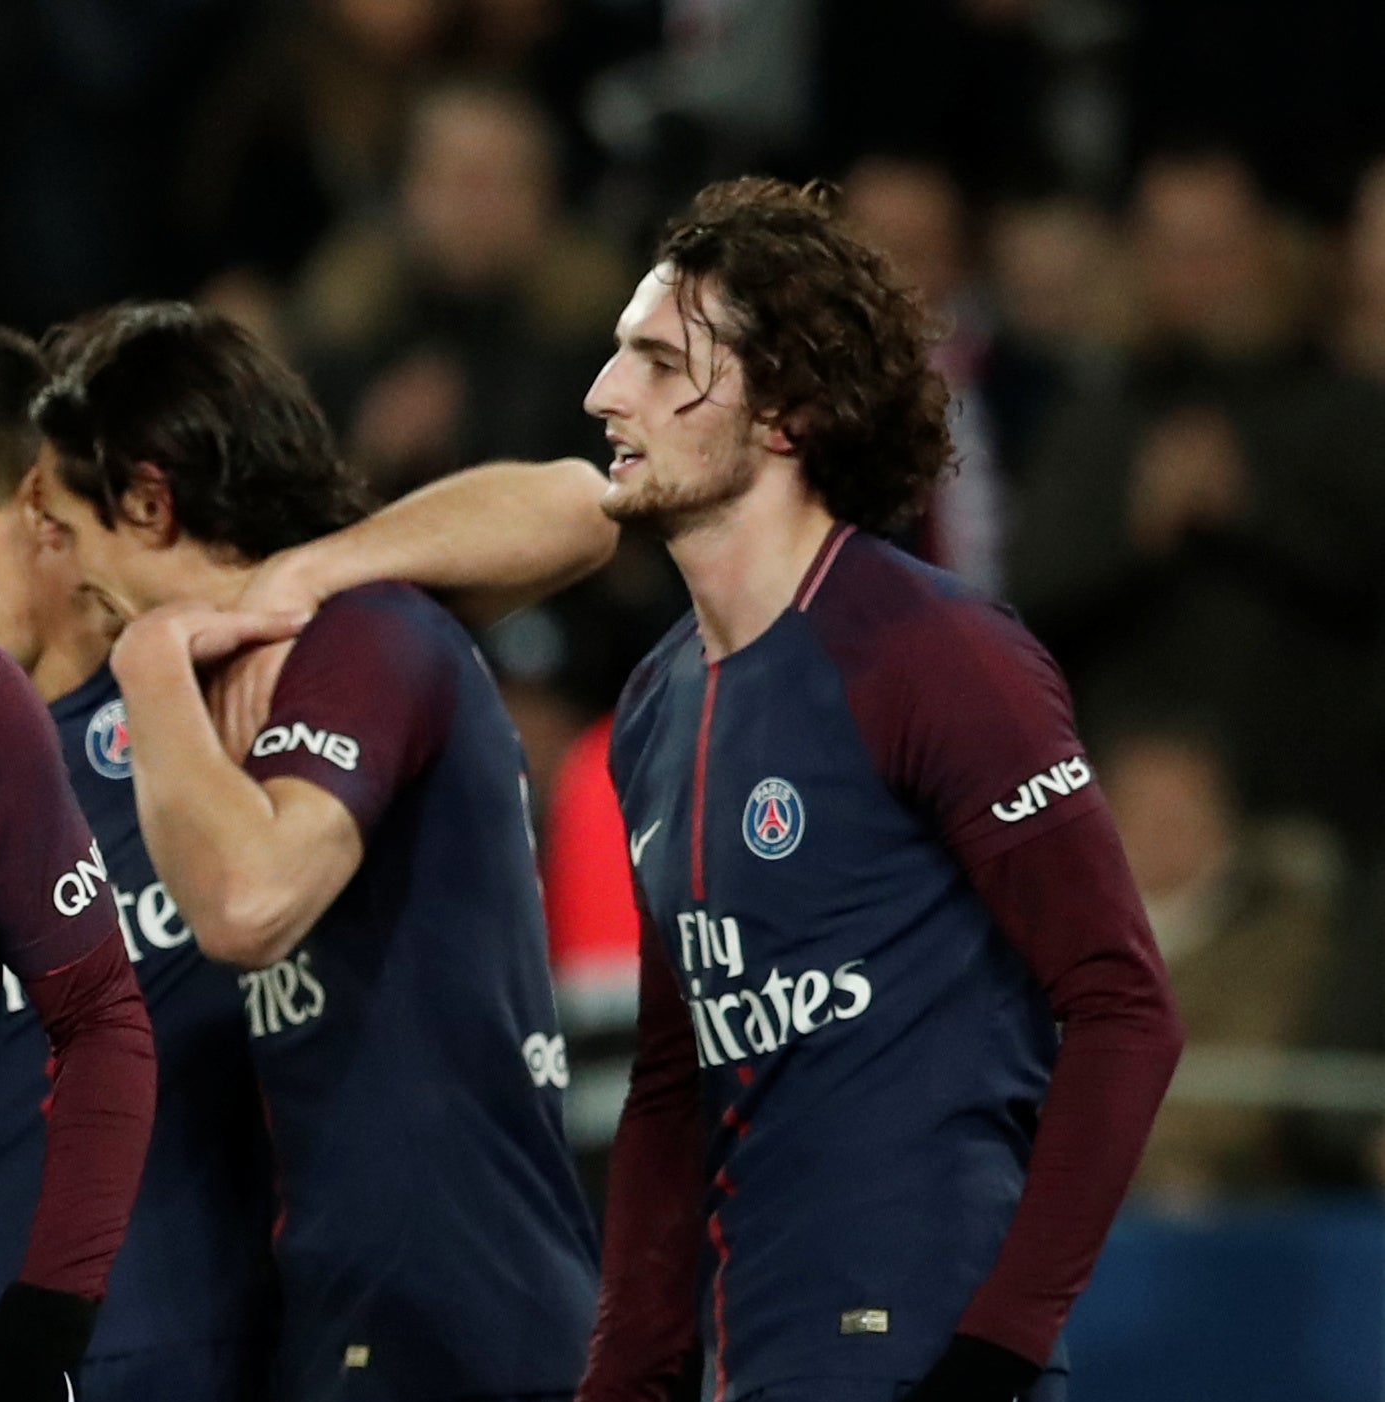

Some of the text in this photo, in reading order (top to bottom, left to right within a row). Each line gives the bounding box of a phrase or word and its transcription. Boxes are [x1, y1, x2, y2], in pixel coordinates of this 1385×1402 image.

[53, 836, 108, 917] QN
[677, 910, 745, 978] Fly
[690, 958, 872, 1069] irates
